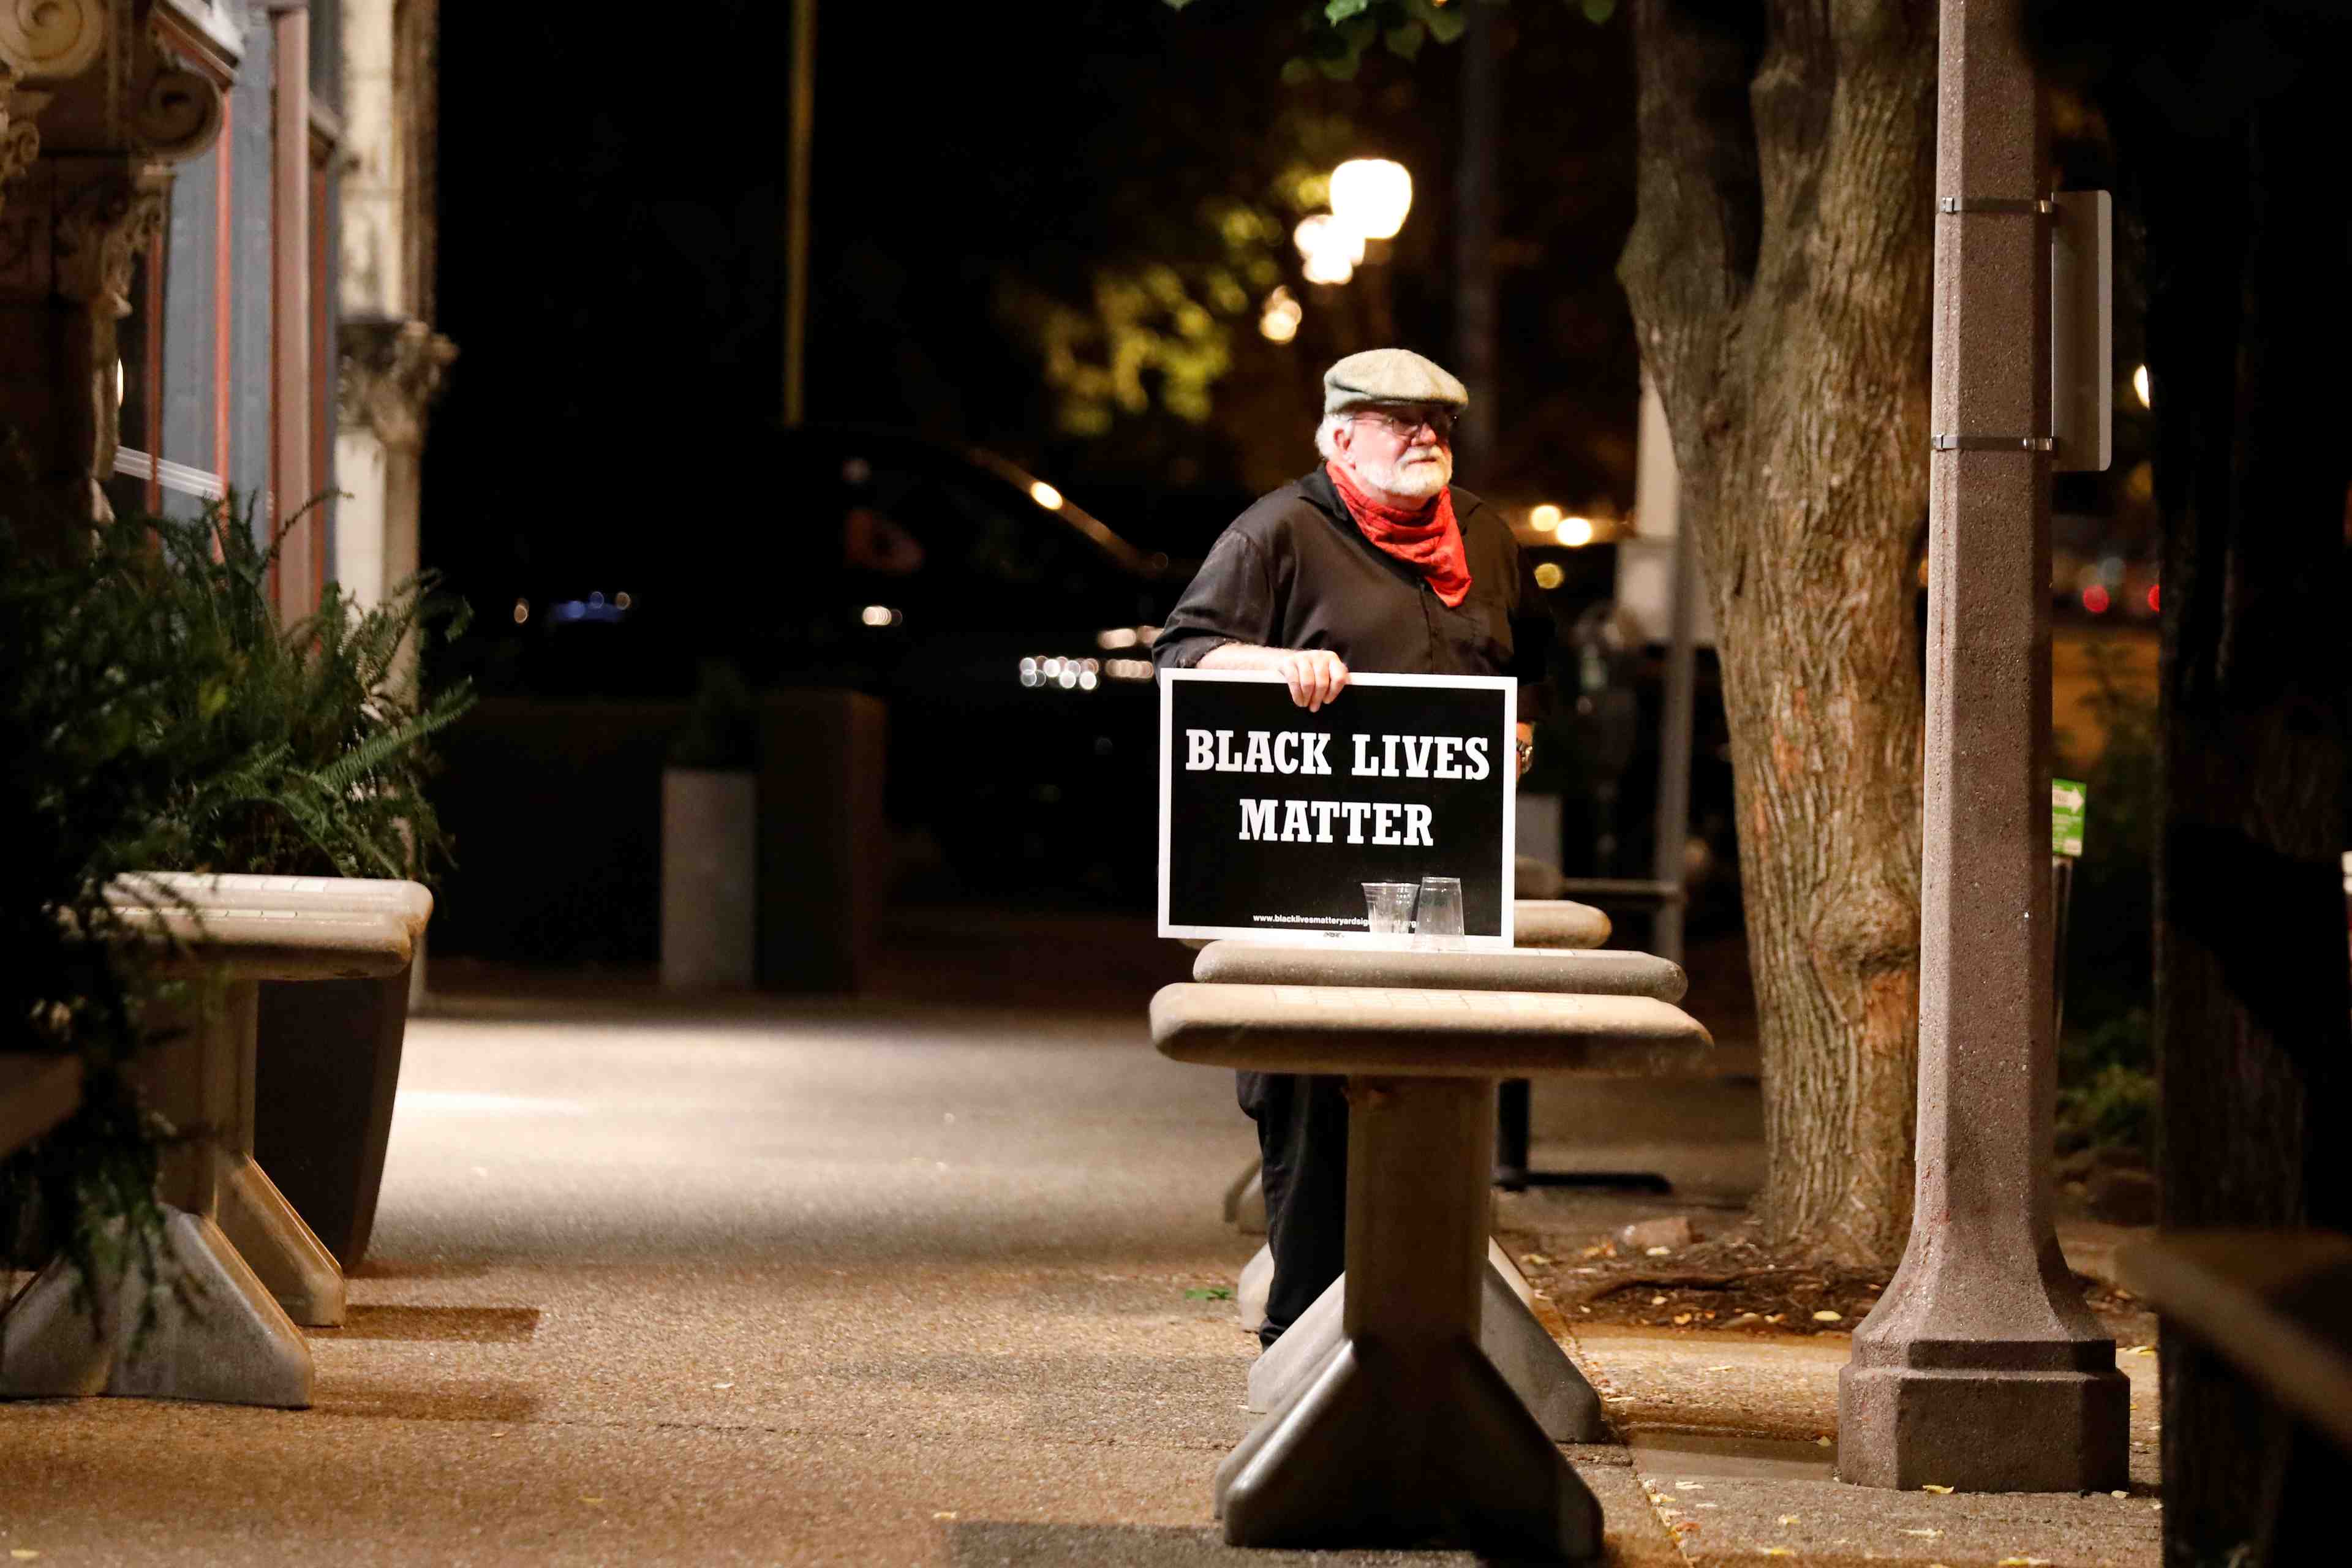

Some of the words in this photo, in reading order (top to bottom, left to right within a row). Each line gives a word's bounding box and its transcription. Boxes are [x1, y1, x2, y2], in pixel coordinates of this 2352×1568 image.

[1185, 729, 1332, 775] BLACK
[1351, 734, 1490, 780] LIVES
[1238, 798, 1434, 846] MATTER
